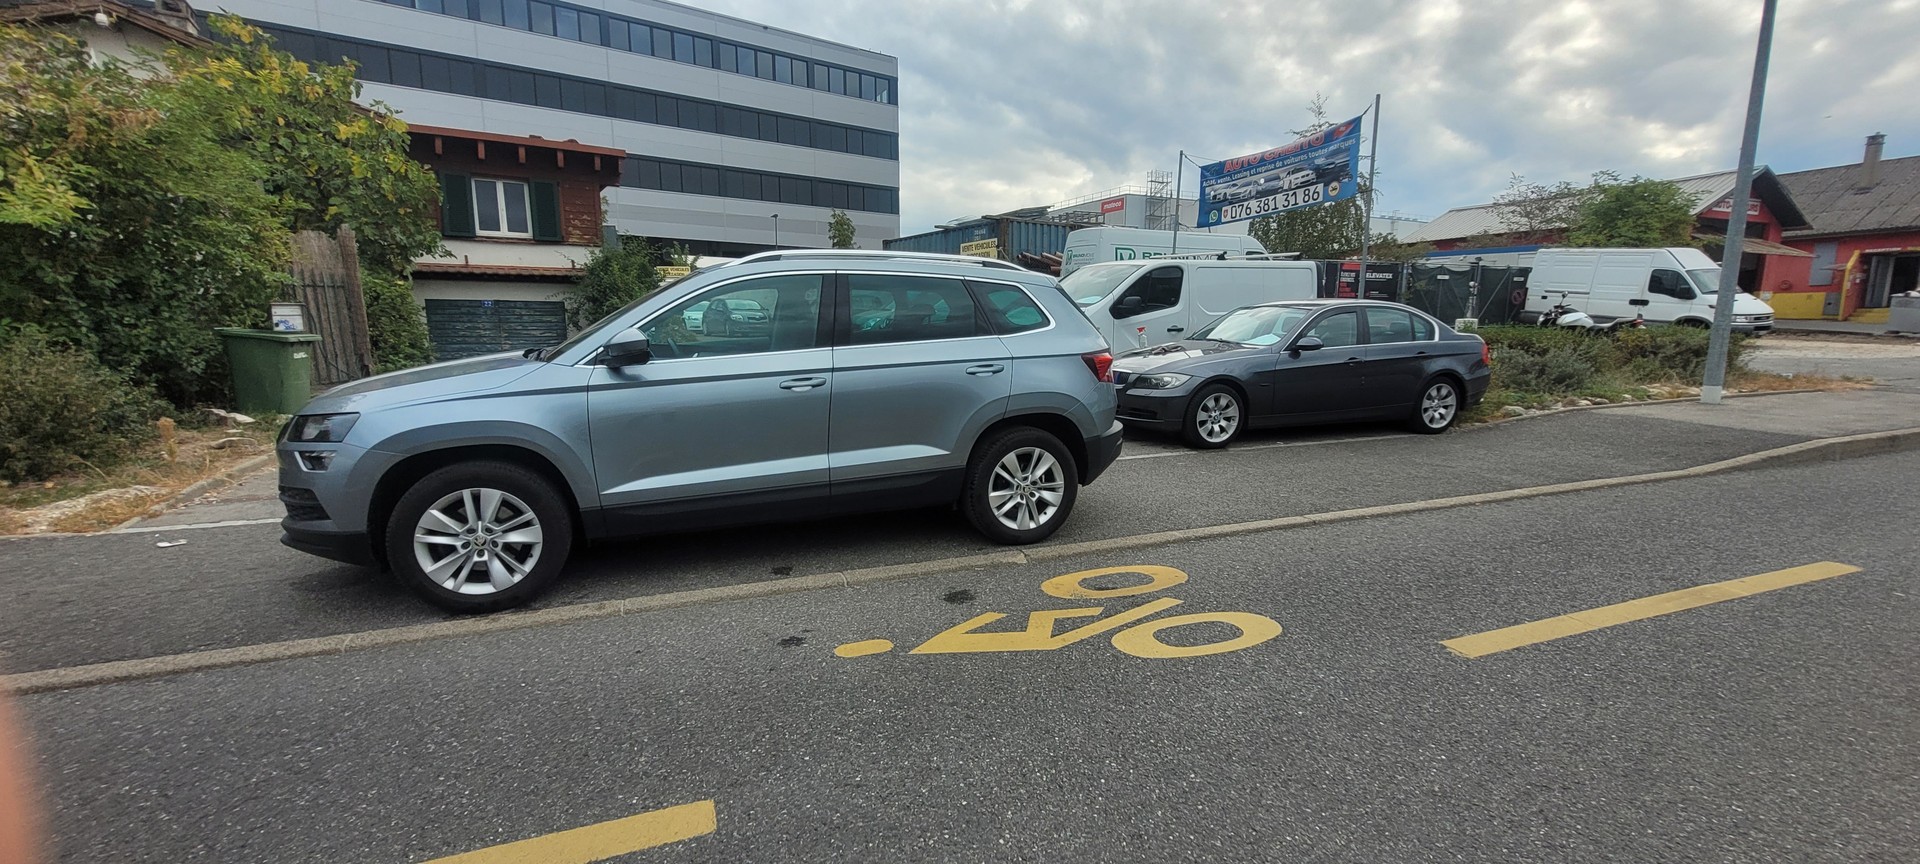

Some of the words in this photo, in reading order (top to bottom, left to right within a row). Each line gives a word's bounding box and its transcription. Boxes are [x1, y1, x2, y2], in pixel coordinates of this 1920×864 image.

[1223, 153, 1262, 173] AUTO
[1231, 170, 1250, 181] Leasing
[1250, 168, 1257, 176] et
[1256, 163, 1275, 174] reprise
[1275, 160, 1283, 168] de
[1283, 153, 1308, 166] voitures
[1308, 147, 1328, 159] toutes
[1328, 138, 1357, 153] marques
[1230, 202, 1252, 219] 076
[1255, 196, 1279, 214] 381
[1282, 191, 1299, 208] 31
[1303, 186, 1320, 203] 86
[961, 244, 974, 253] VENTE
